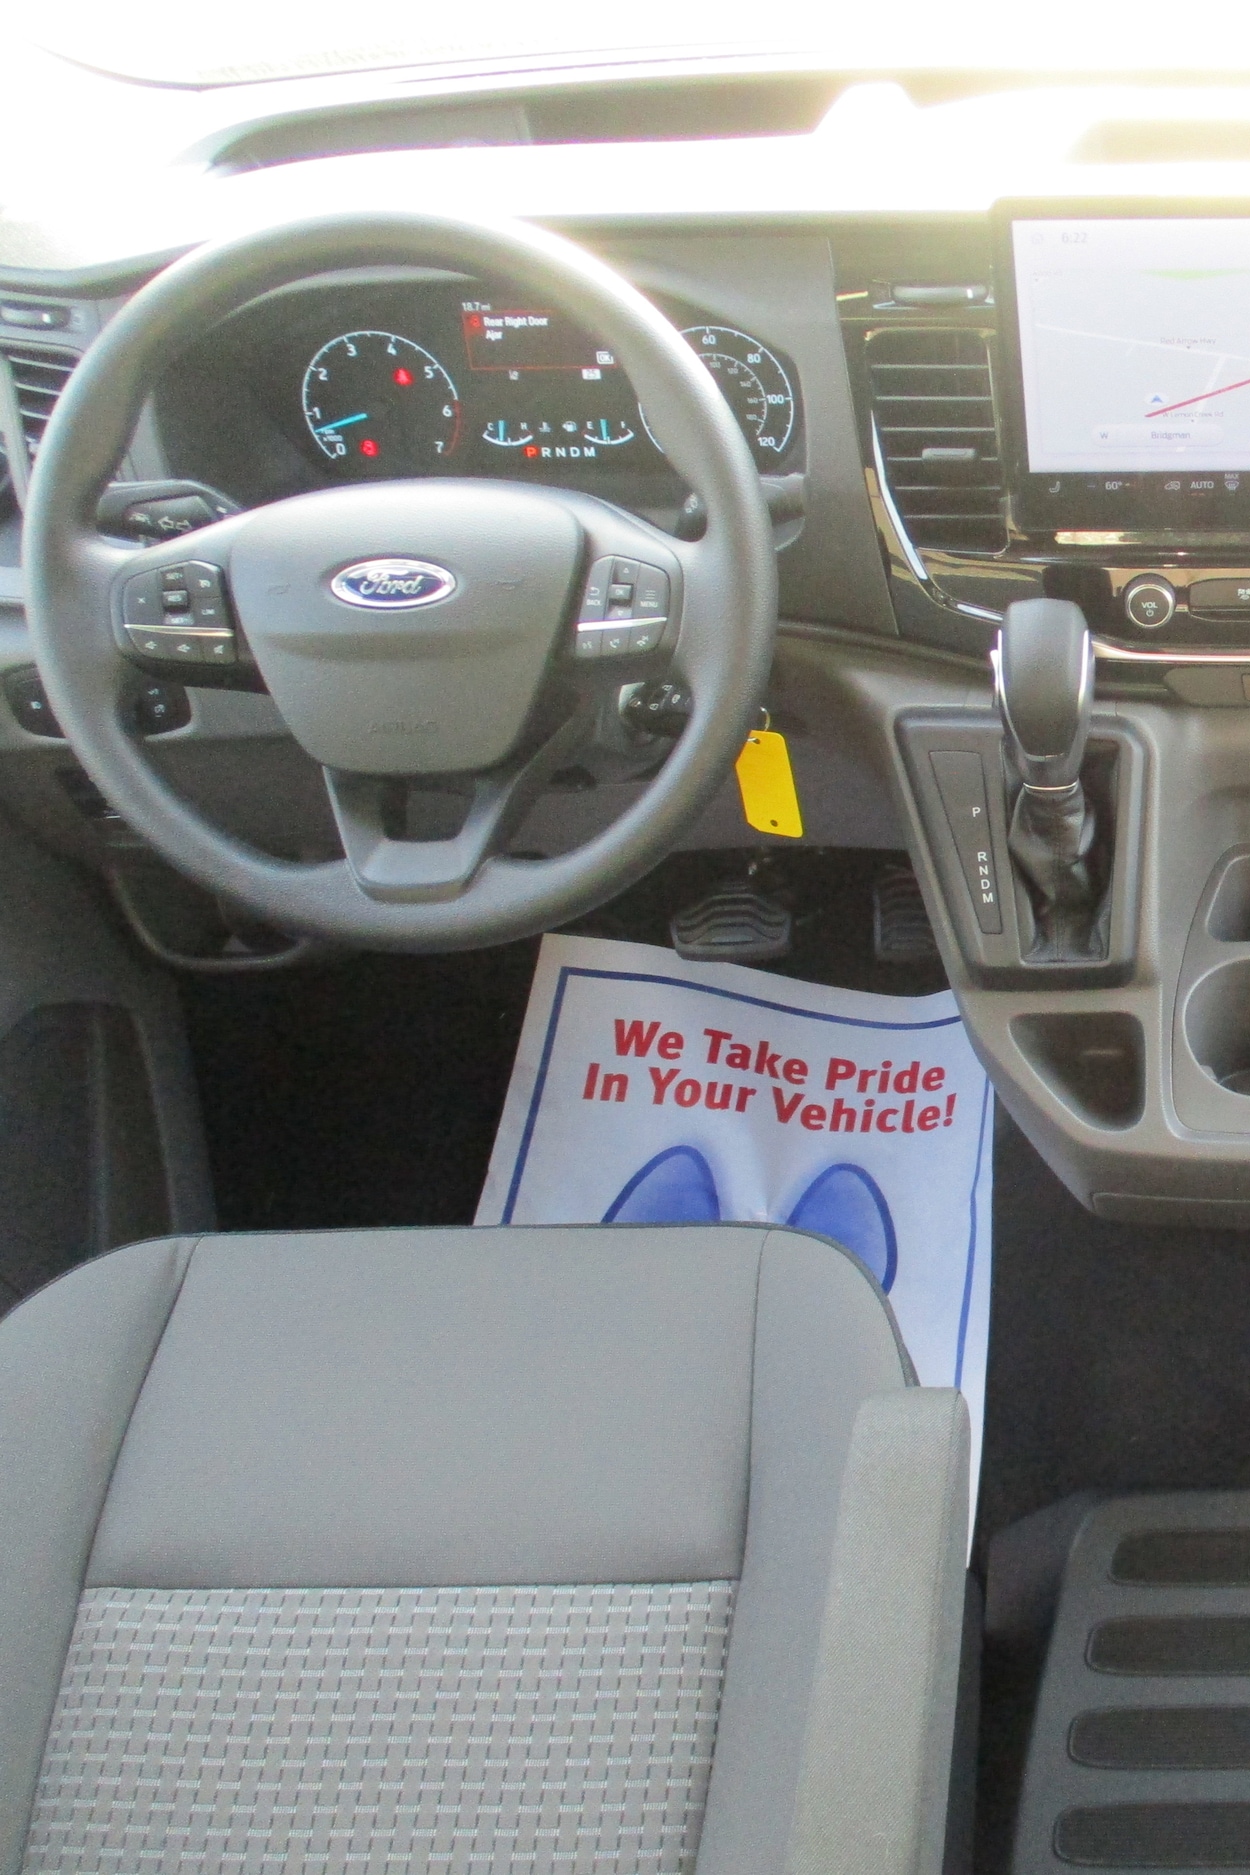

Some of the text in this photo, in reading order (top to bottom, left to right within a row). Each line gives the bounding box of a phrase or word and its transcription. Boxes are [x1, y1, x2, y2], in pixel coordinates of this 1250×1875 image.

[1061, 232, 1088, 244] 6:22
[483, 316, 548, 328] Rear Right Door
[486, 330, 503, 341] Ajar
[702, 335, 716, 344] 60
[347, 344, 357, 356] 3
[387, 344, 397, 356] 4
[747, 354, 761, 364] 80
[318, 368, 328, 381] 2
[424, 366, 434, 379] 5
[766, 394, 784, 404] 100
[442, 405, 452, 418] 6
[1100, 430, 1191, 440] W Bridgman
[434, 441, 444, 454] 7
[757, 437, 775, 447] 120
[336, 442, 346, 455] 0
[542, 446, 552, 458] R
[556, 446, 566, 458] N
[570, 446, 580, 458] D
[584, 446, 596, 458] M
[1190, 480, 1214, 490] AUTO
[360, 569, 422, 595] Ford
[972, 806, 981, 818] P
[977, 852, 988, 862] R
[979, 865, 989, 876] N
[980, 879, 990, 890] D
[982, 892, 994, 904] M
[614, 1018, 946, 1094] We Take Pride
[582, 1062, 958, 1134] In Your Vehicle!
